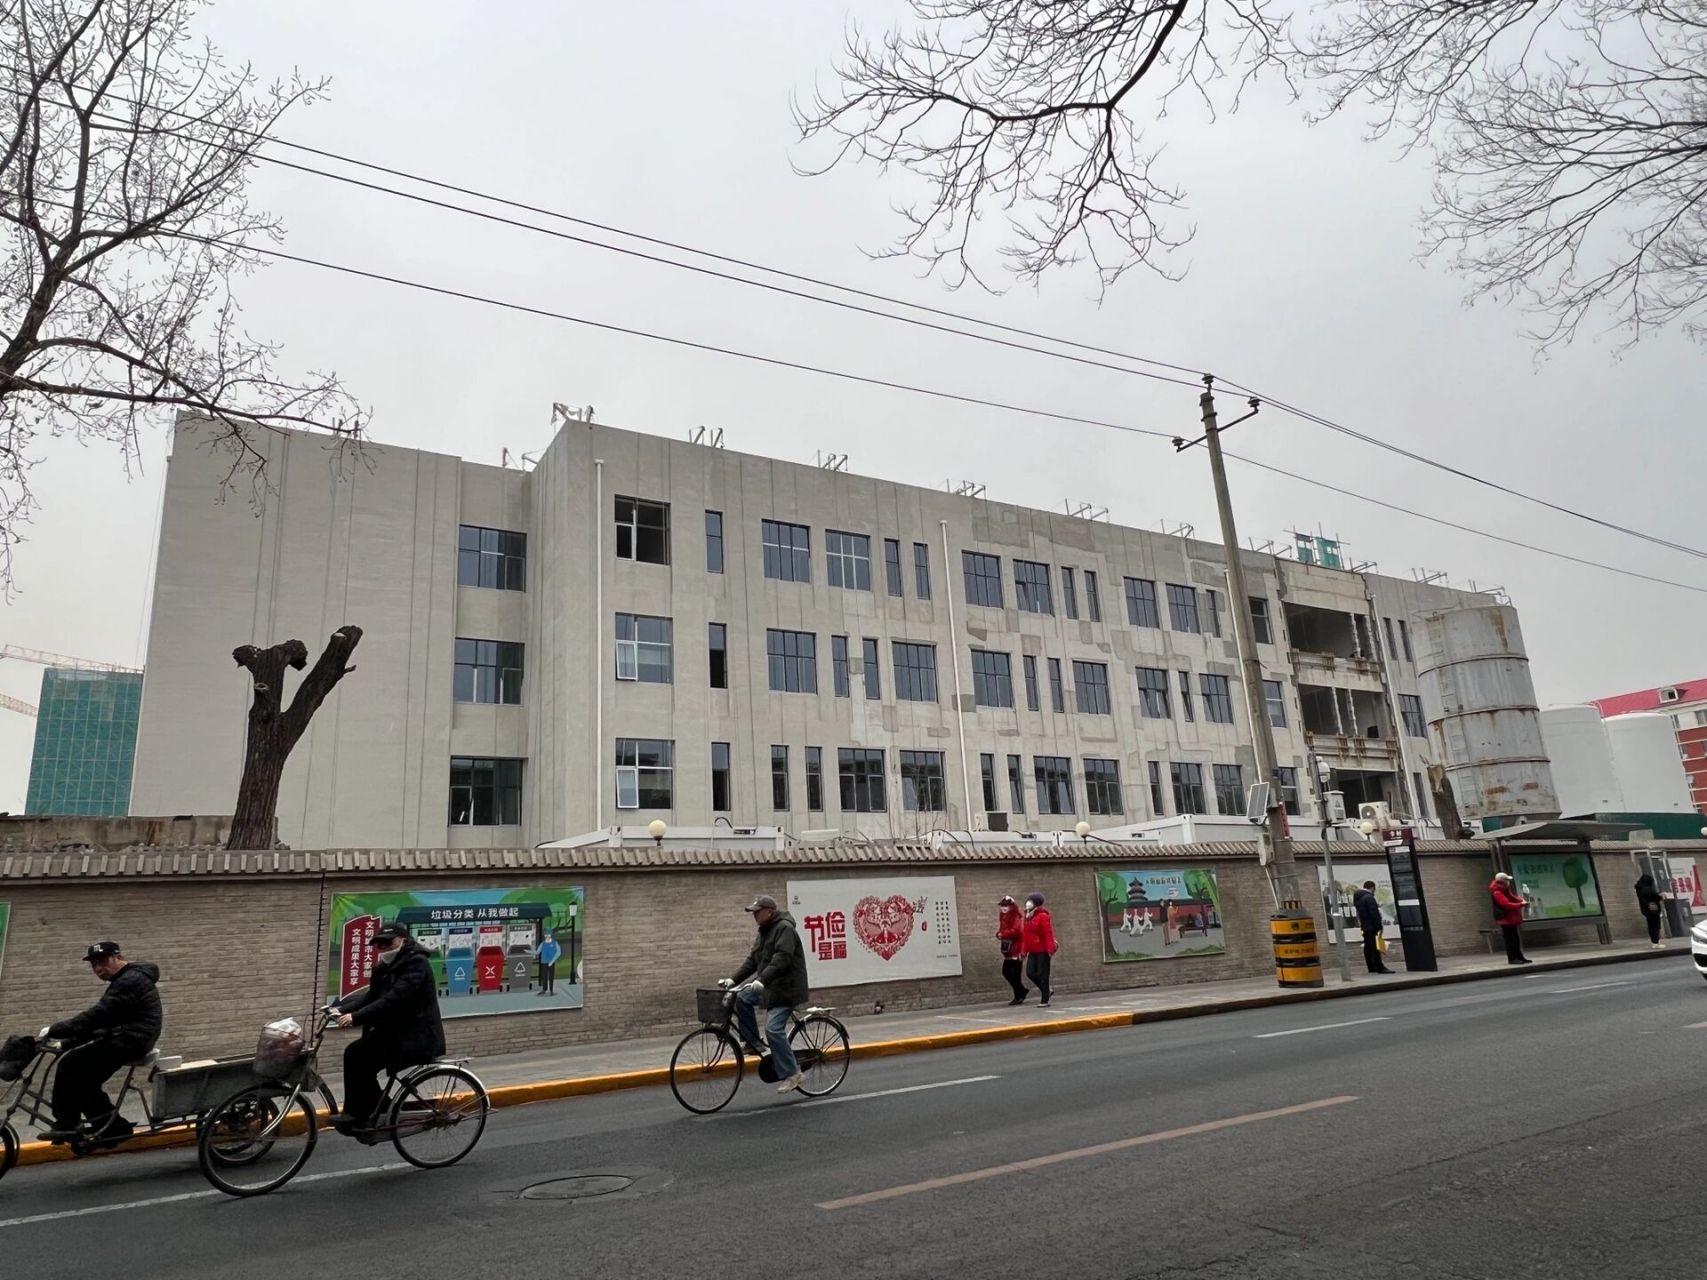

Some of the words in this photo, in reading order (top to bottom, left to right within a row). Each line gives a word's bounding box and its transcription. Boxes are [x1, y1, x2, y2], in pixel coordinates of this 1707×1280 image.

[431, 909, 474, 920] 垃圾分类
[477, 907, 519, 918] 从我做起
[804, 912, 846, 953] 节俭
[350, 928, 361, 986] 文明成果大家享
[818, 941, 847, 960] 是福
